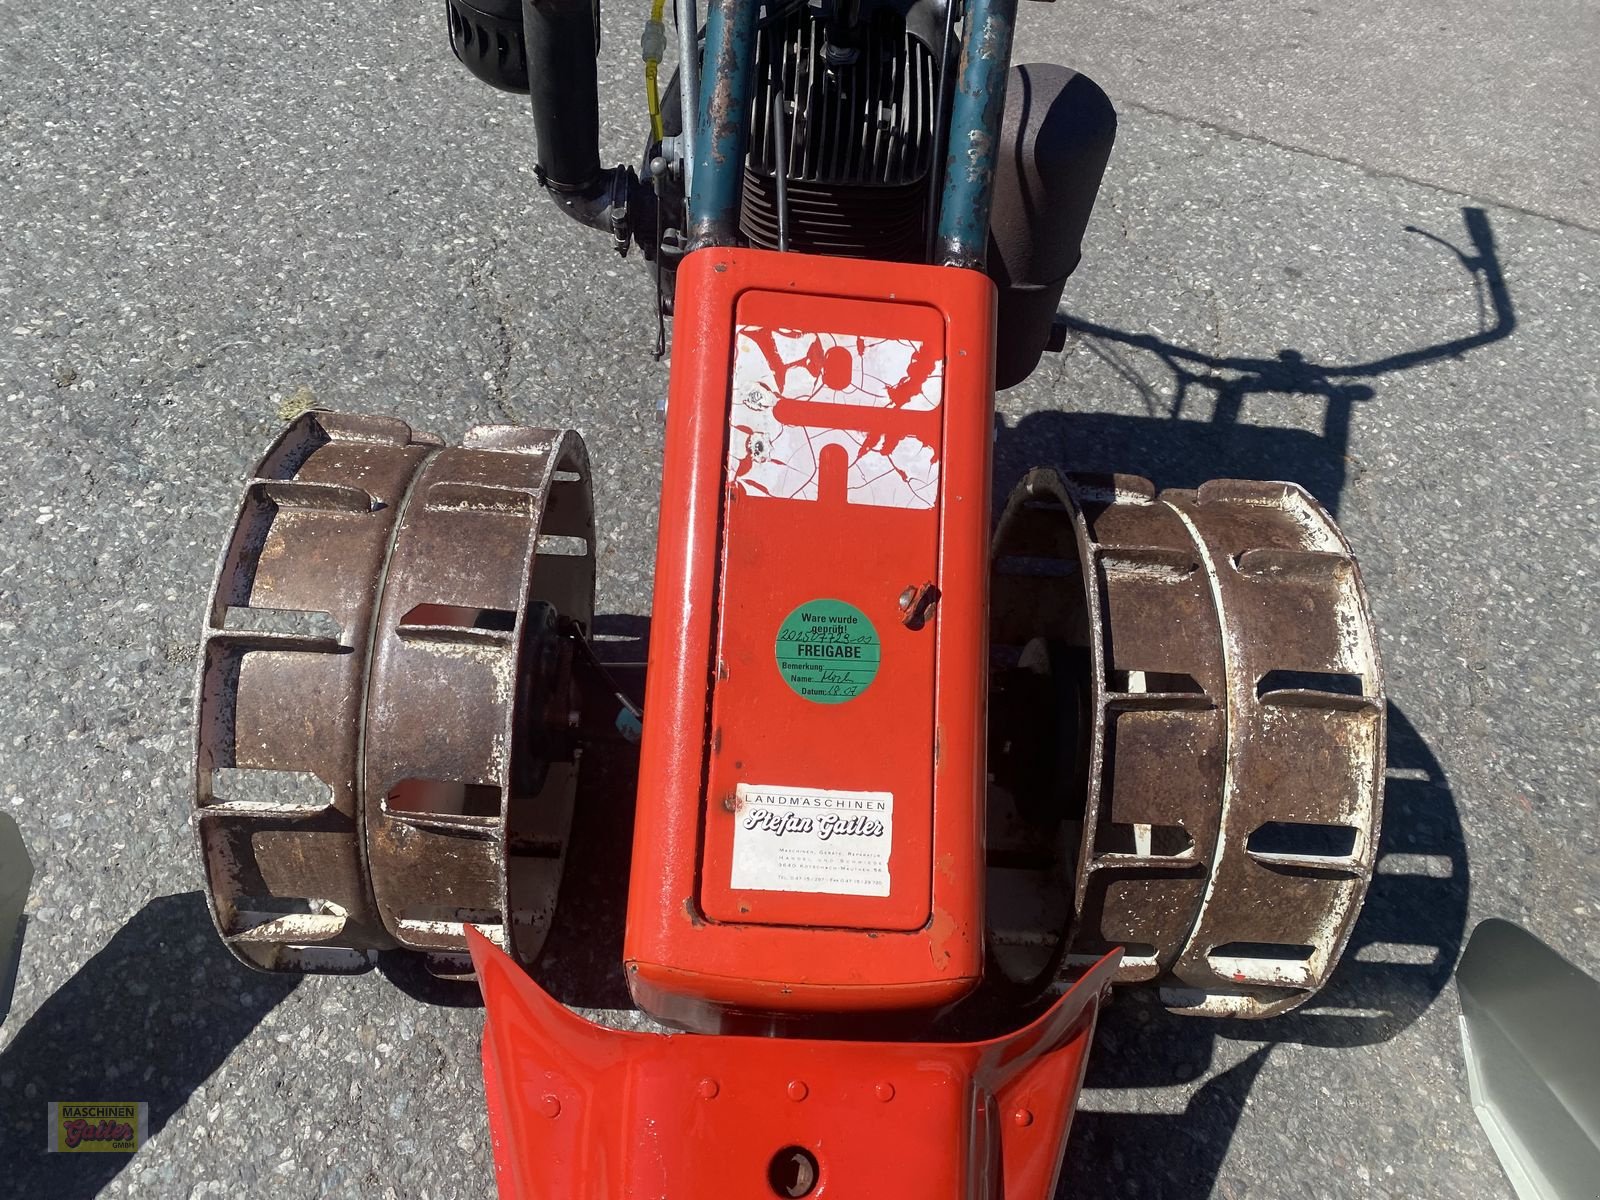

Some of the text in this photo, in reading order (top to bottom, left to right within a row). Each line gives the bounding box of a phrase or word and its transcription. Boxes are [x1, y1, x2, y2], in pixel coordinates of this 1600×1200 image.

[802, 613, 857, 624] Ware wurde
[798, 644, 861, 659] FREIGABE
[801, 687, 827, 696] Datum:
[745, 793, 886, 811] LANDMASCHINEN
[743, 808, 884, 841] Stefan Gailer
